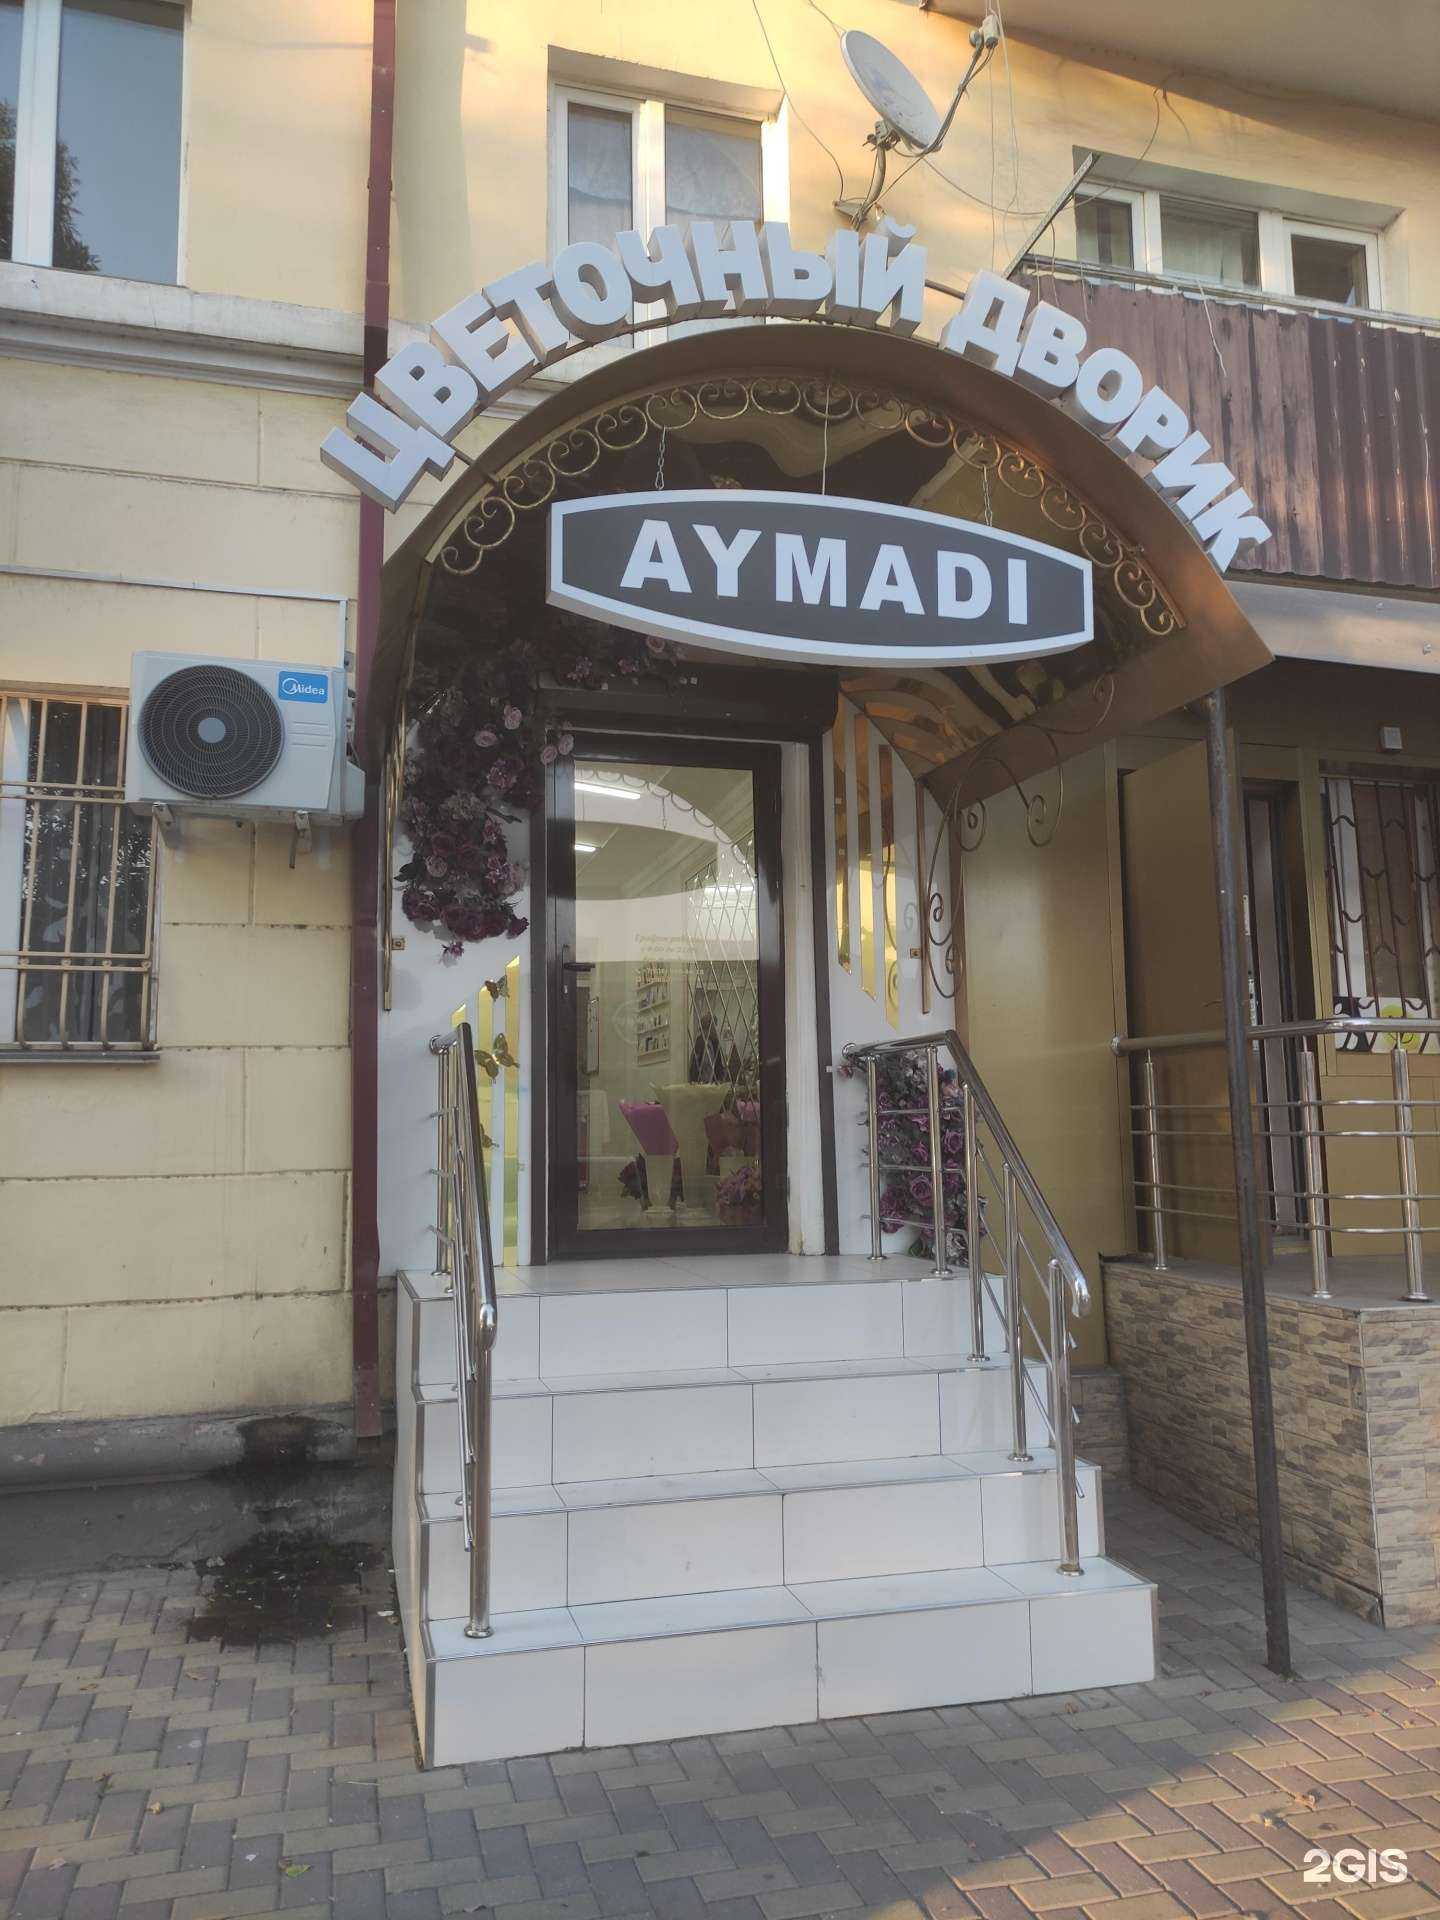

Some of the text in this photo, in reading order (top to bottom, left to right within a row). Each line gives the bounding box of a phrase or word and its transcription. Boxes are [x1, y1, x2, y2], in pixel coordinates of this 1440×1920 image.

[319, 220, 1272, 571] ЦВЕТОЧНЫЙ ДВОРИК
[619, 518, 1028, 625] AYMADI
[283, 678, 325, 695] Midea
